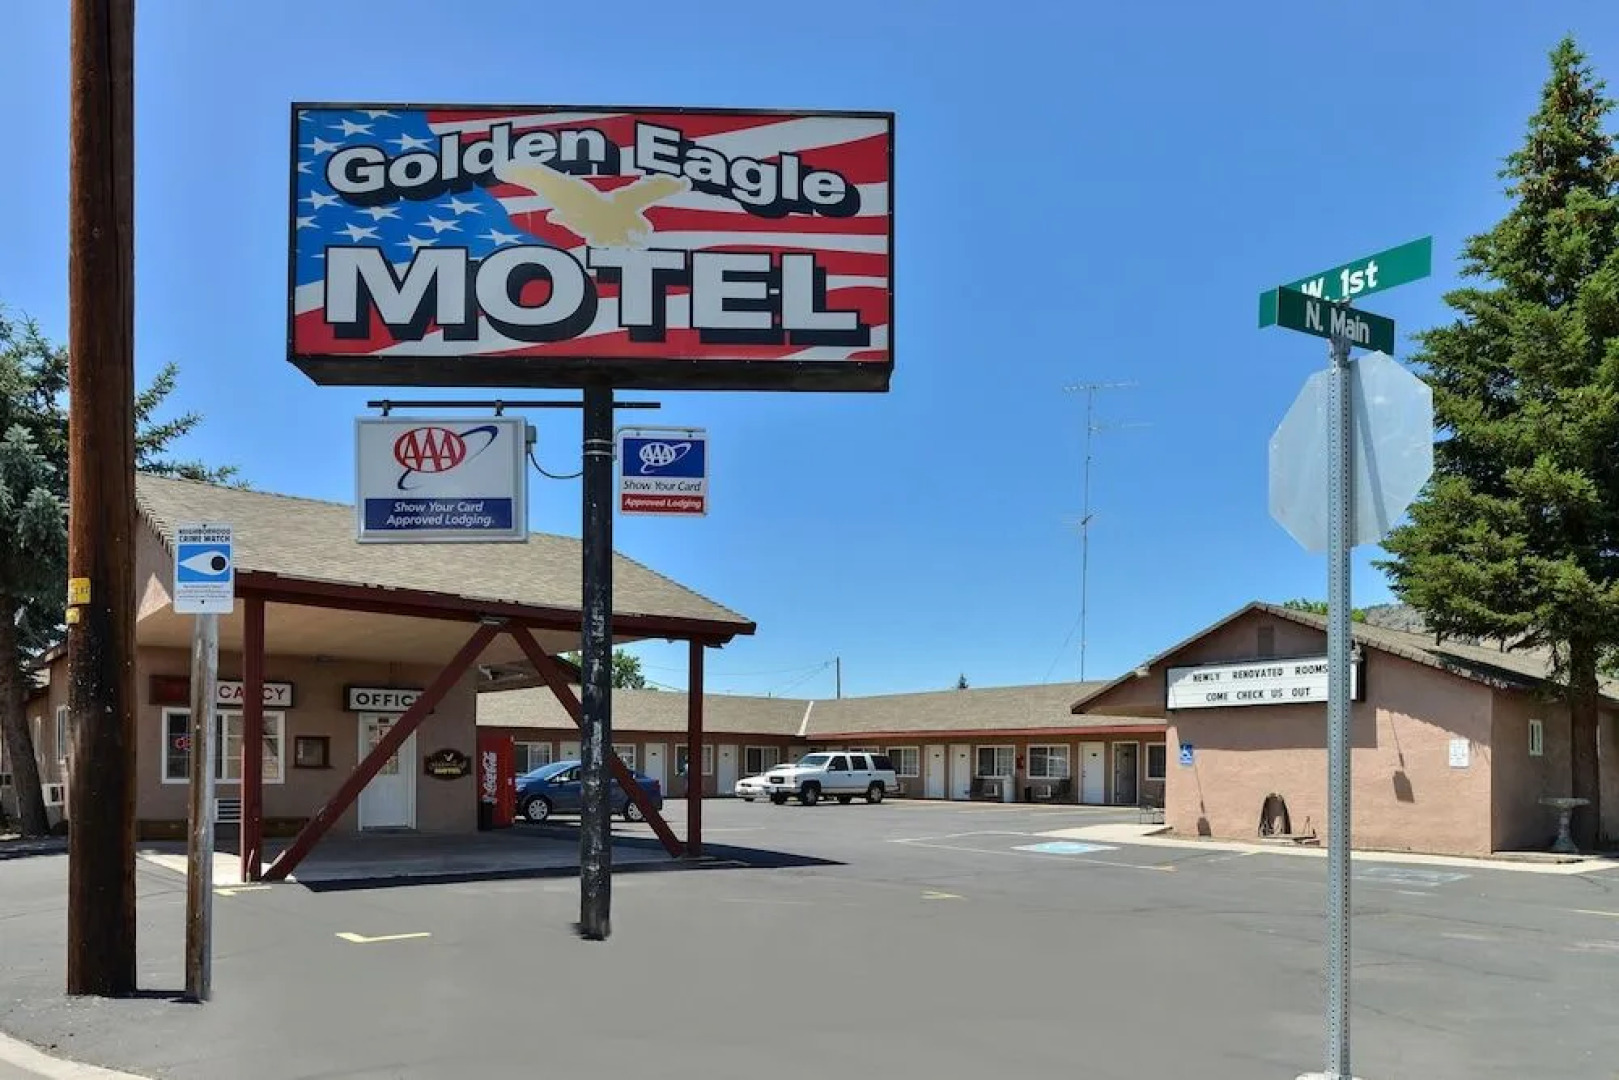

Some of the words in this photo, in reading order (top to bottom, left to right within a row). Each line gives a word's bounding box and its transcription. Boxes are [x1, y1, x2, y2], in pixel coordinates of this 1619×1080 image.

[326, 121, 618, 206] Golden
[634, 120, 862, 218] Eagle
[1340, 260, 1378, 297] 1st
[324, 244, 874, 346] MOTEL
[1305, 301, 1324, 331] N.
[1331, 307, 1370, 344] Main
[625, 480, 650, 490] Show
[655, 481, 676, 491] Your
[678, 480, 702, 492] Card
[394, 501, 426, 513] Show
[429, 501, 454, 513] Your
[457, 501, 485, 513] Card
[387, 514, 443, 527] Approved
[1192, 671, 1221, 683] NEWLY
[1232, 667, 1284, 680] RENOVATED
[1294, 663, 1329, 676] ROOMS
[355, 692, 421, 707] OFFIC
[1205, 691, 1229, 702] COME
[1236, 688, 1264, 700] CHECK
[1270, 687, 1284, 698] US
[1291, 686, 1311, 697] OUT
